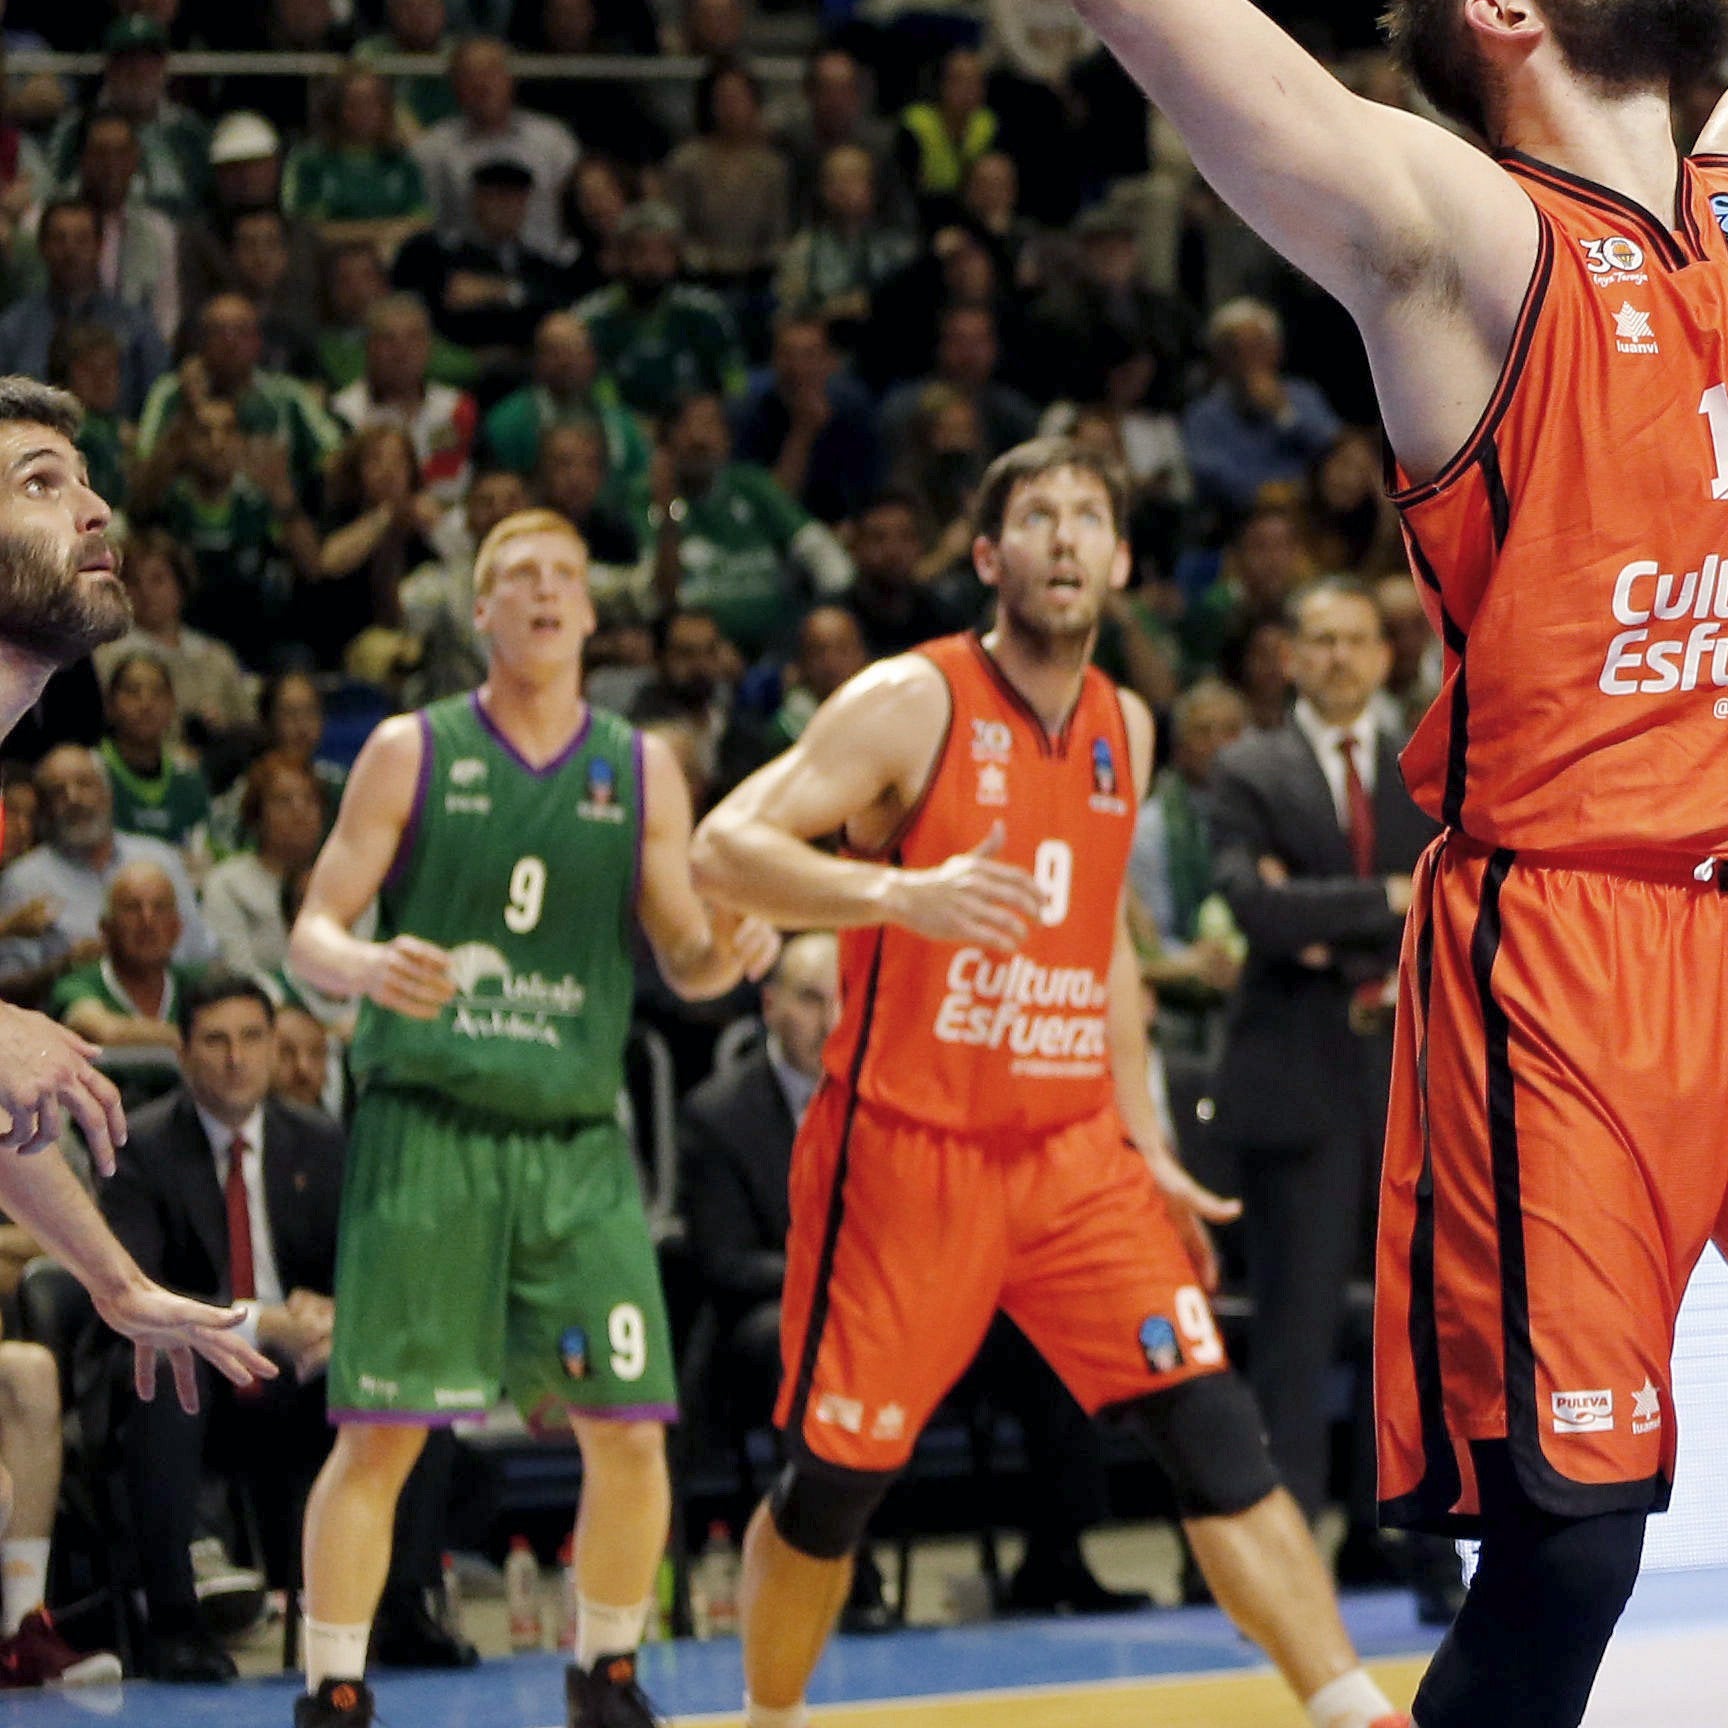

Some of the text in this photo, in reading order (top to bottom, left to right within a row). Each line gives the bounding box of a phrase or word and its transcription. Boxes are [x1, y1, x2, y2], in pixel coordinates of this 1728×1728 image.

[1615, 339, 1659, 354] luanvi
[504, 854, 547, 935] 9
[1033, 838, 1073, 927] 9
[947, 946, 1095, 1008] Cultura
[607, 1303, 647, 1382] 9
[1174, 1284, 1224, 1365] 9
[1556, 1396, 1608, 1409] PULEVA
